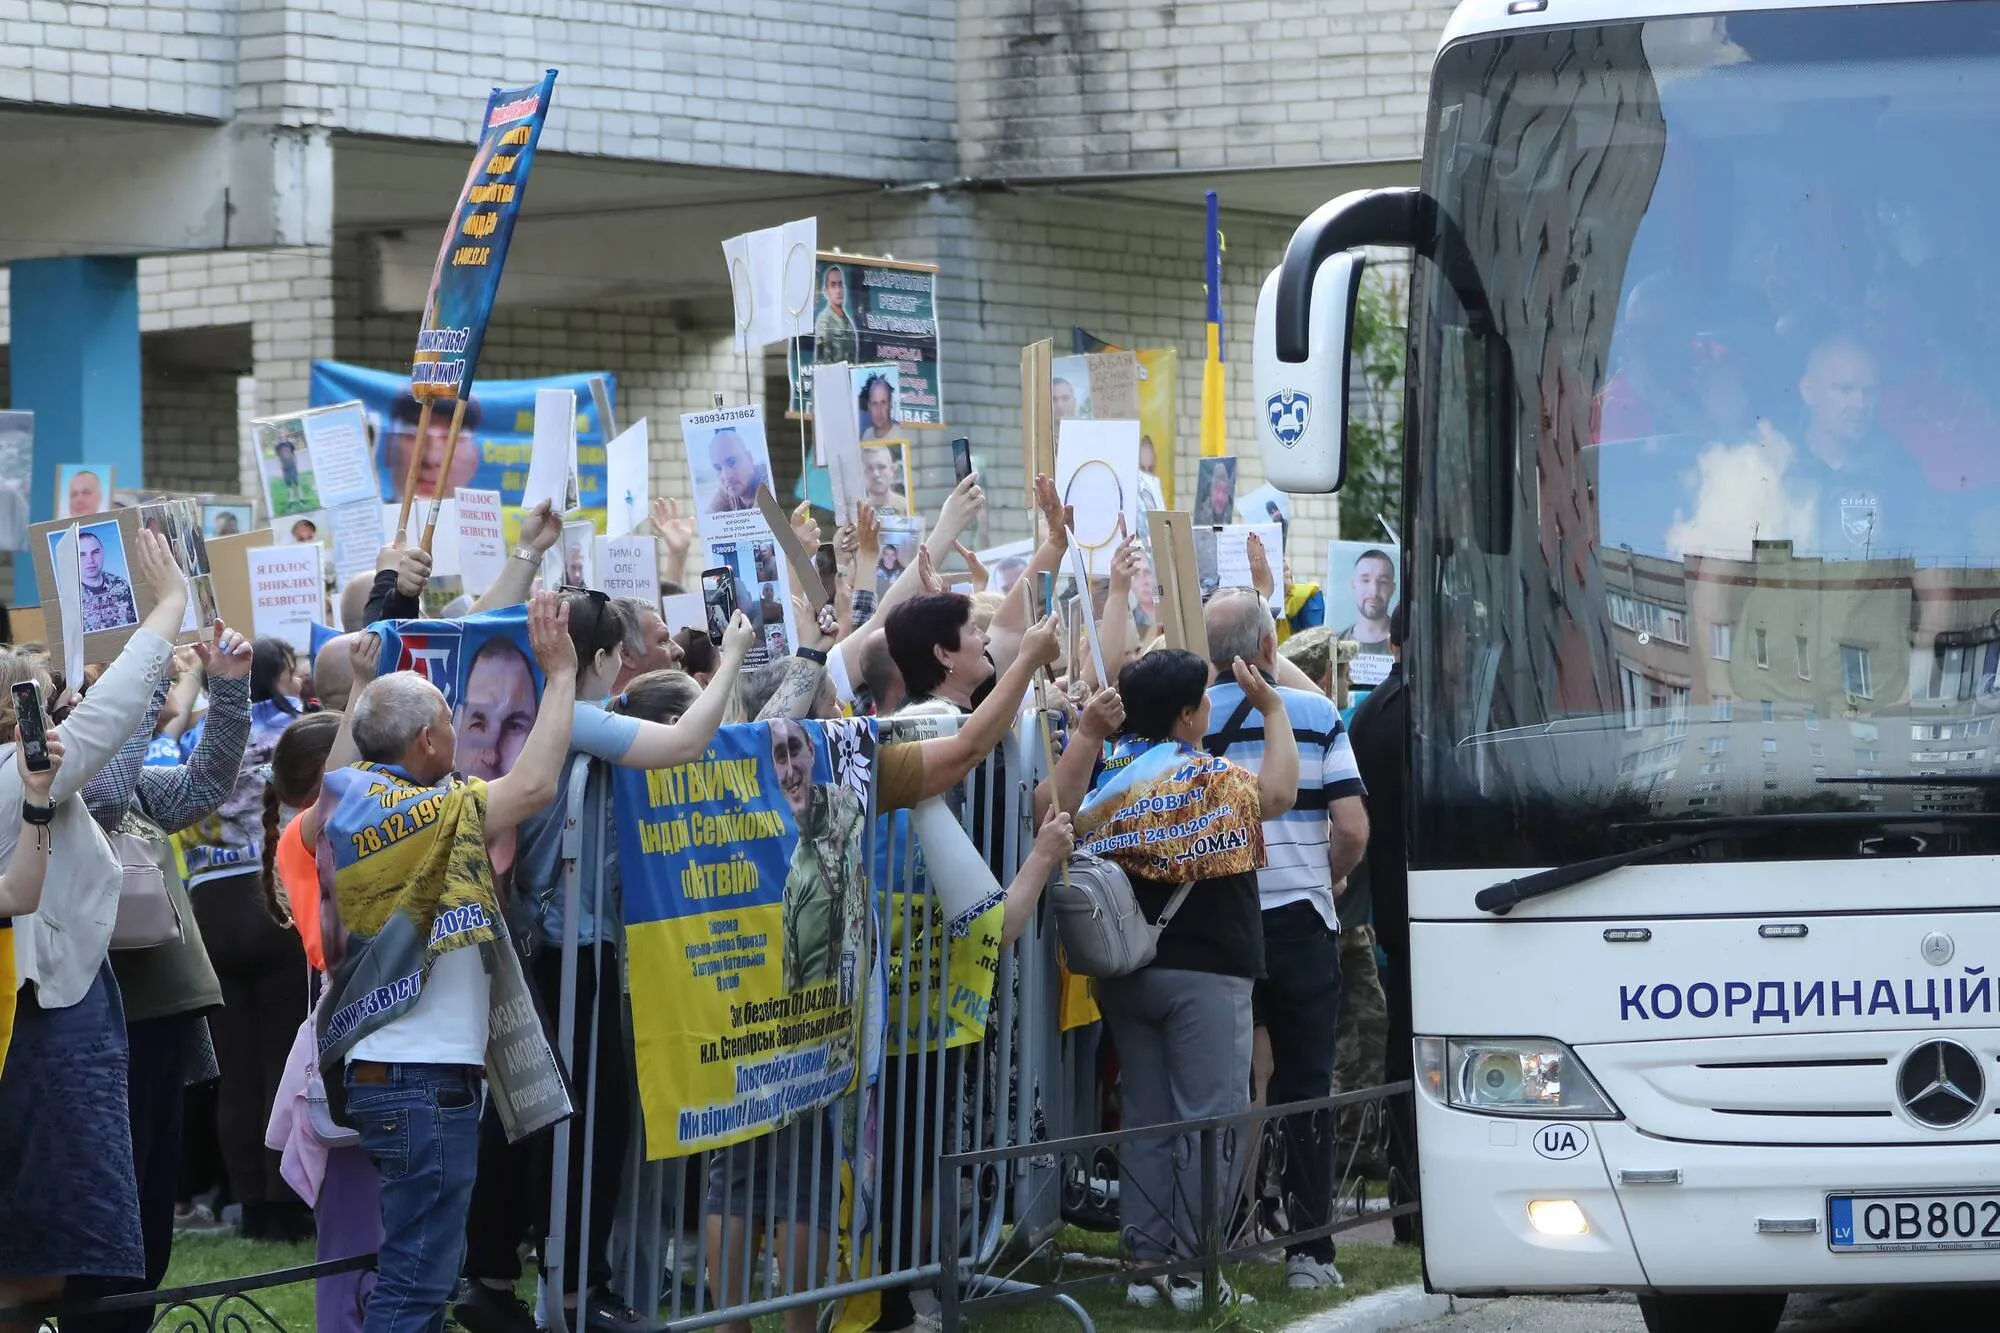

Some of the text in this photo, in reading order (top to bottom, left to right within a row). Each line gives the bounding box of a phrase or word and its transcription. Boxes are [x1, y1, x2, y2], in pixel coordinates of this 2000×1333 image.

[689, 409, 755, 425] +380934731862
[608, 548, 640, 558] ТИМО
[614, 563, 637, 573] ОЛЕ
[258, 593, 316, 607] БЕЗВІСТИ
[352, 794, 444, 859] 28.12.19
[428, 902, 492, 948] .2025.
[744, 997, 791, 1025] безвісти
[679, 1111, 700, 1141] Ми
[1543, 1132, 1577, 1152] UA
[1864, 1200, 2000, 1240] QB802
[1835, 1228, 1851, 1238] LV
